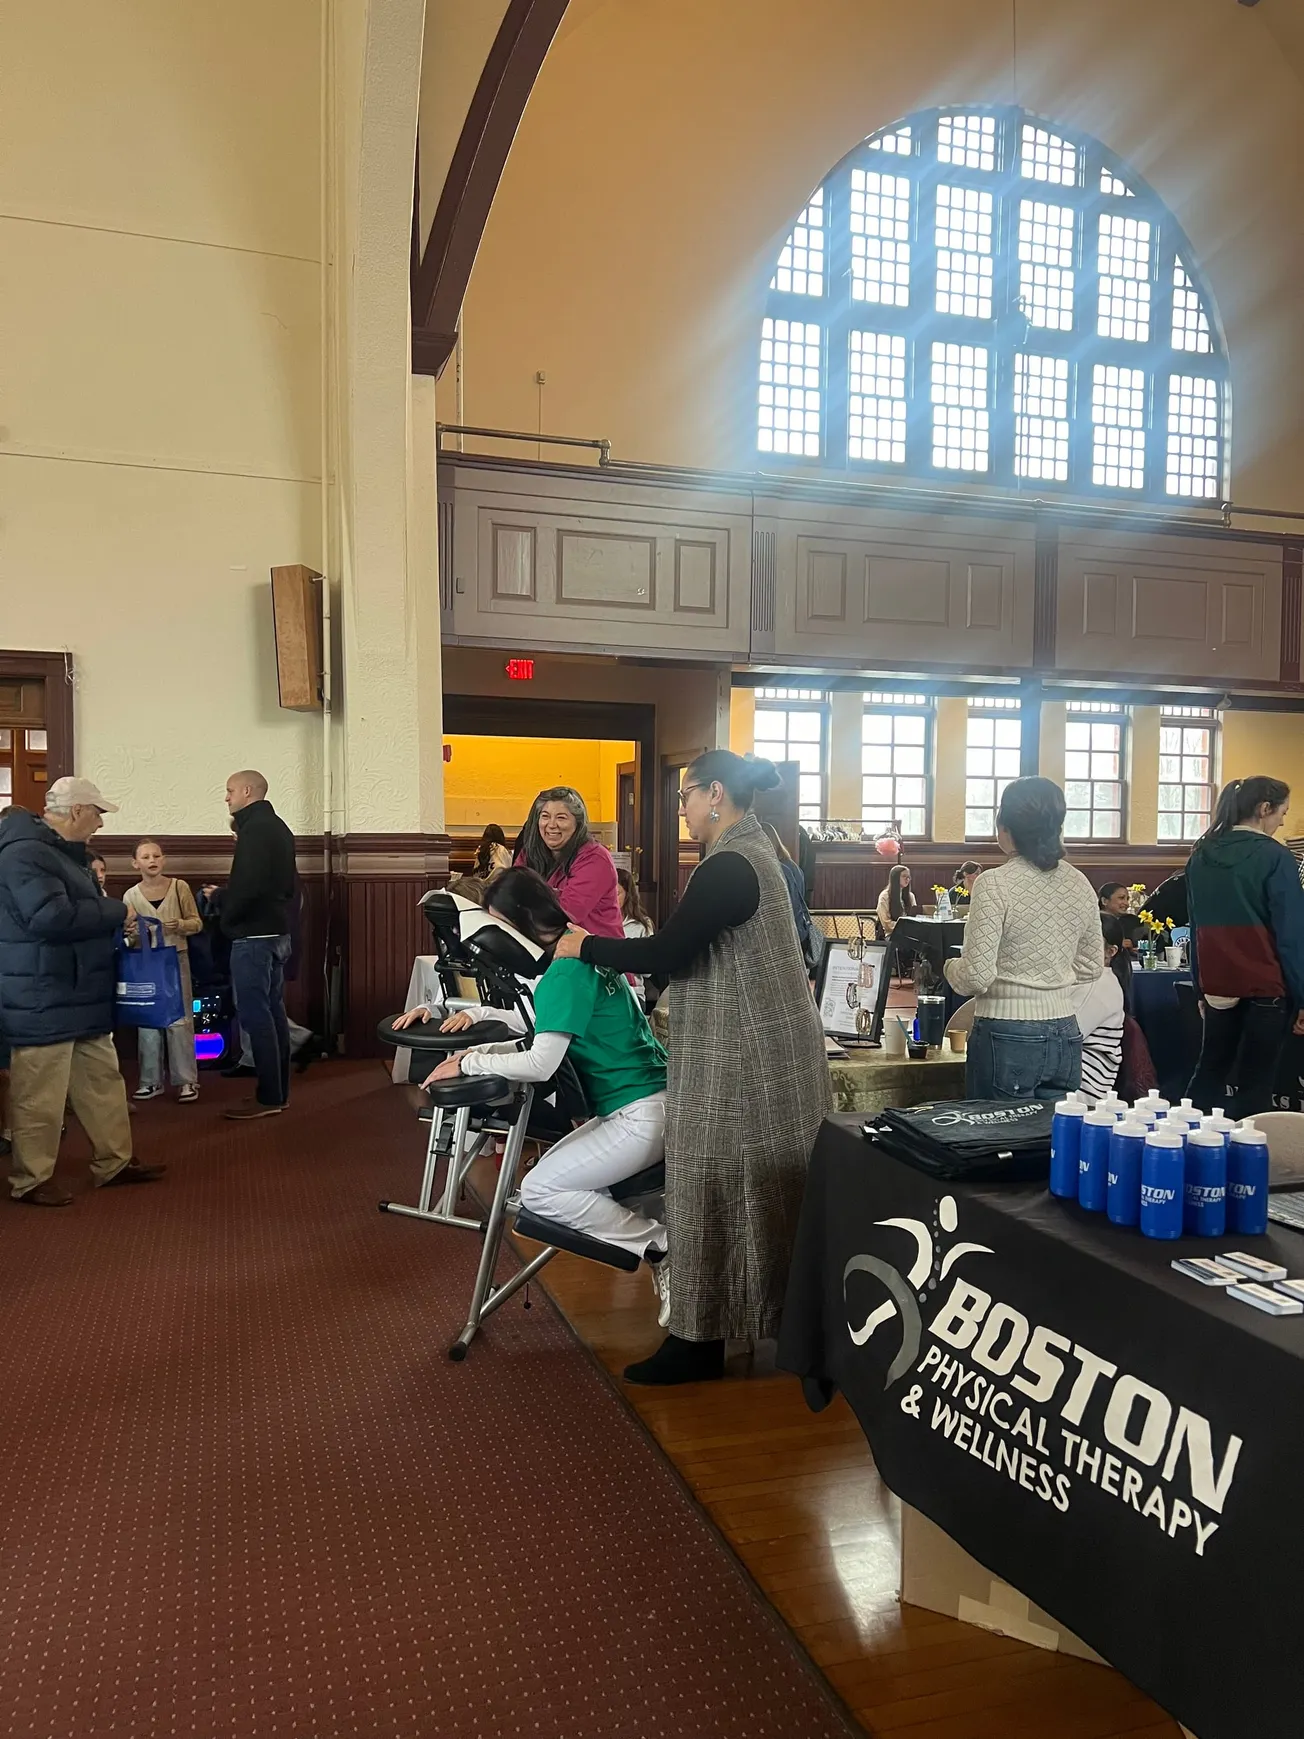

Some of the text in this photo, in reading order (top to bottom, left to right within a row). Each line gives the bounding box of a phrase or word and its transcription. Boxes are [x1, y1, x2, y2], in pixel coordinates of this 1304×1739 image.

[510, 659, 534, 679] EXIT
[968, 1104, 1043, 1120] BOSTON
[901, 1384, 1071, 1512] & WELLNESS
[916, 1345, 1220, 1557] PHYSICAL THERAPY
[928, 1277, 1243, 1515] BOSTON
